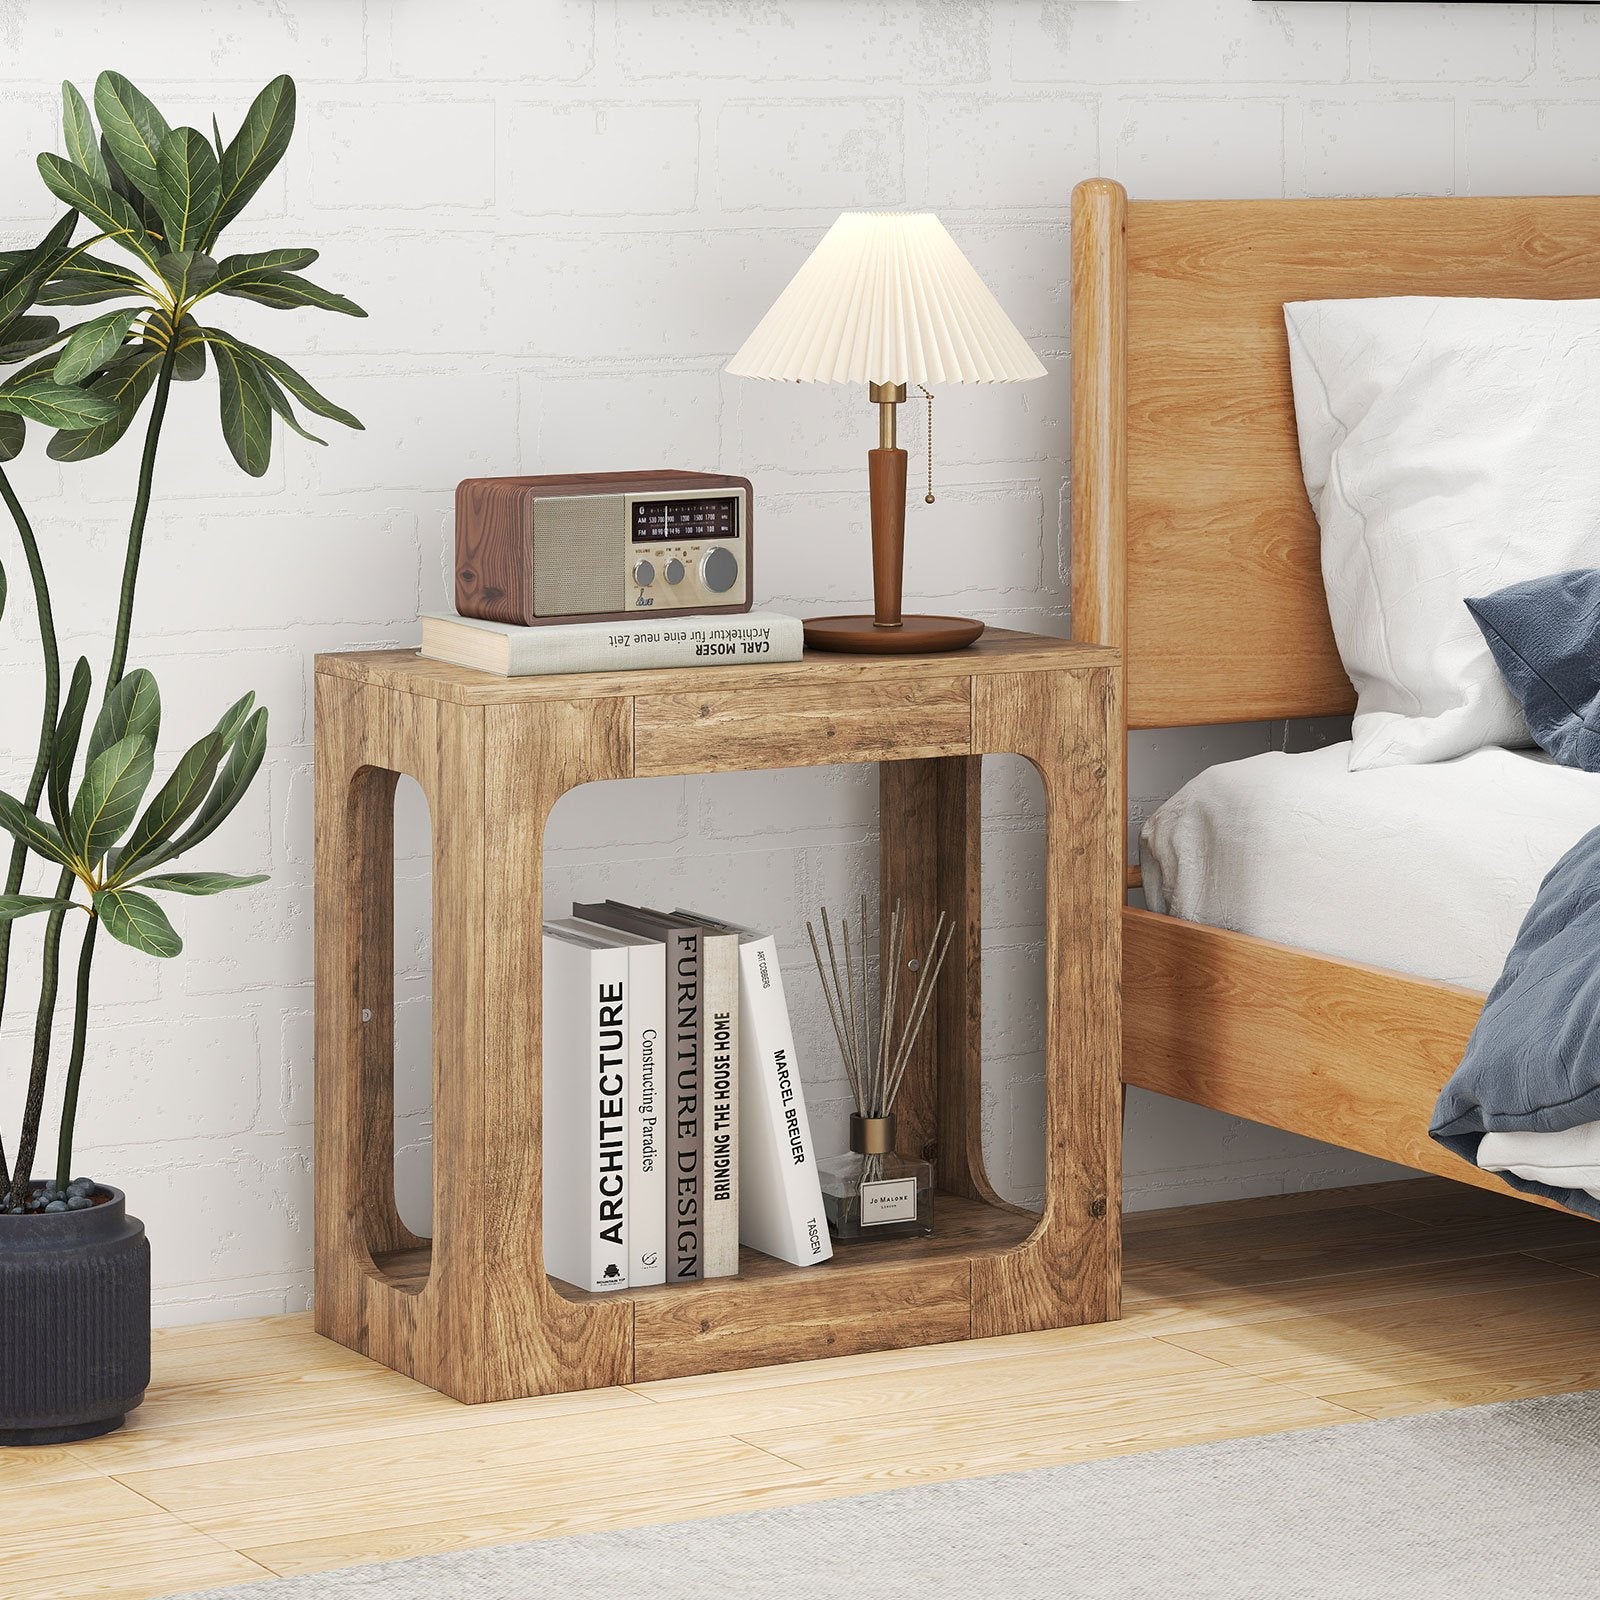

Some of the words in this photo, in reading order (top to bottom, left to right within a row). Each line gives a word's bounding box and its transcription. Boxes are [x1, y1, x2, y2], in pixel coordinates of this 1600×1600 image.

[608, 635, 631, 648] Zeit
[634, 632, 660, 643] neue
[664, 632, 687, 644] eine
[690, 630, 706, 642] für
[695, 643, 736, 656] MOSER
[709, 628, 770, 640] Architektur
[741, 642, 770, 654] CARL
[678, 934, 697, 1138] FURNITURE
[714, 1012, 730, 1052] HOME
[638, 1029, 658, 1113] Constructing
[714, 1054, 730, 1100] HOUSE
[599, 982, 623, 1244] ARCHITECTURE
[714, 1103, 730, 1130] THE
[774, 1049, 794, 1107] MARCEL
[785, 1108, 805, 1165] BREUER
[642, 1117, 658, 1172] Paradies
[714, 1134, 730, 1200] BRINGING
[678, 1149, 697, 1278] DESIGN
[807, 1218, 821, 1255] TASCEN
